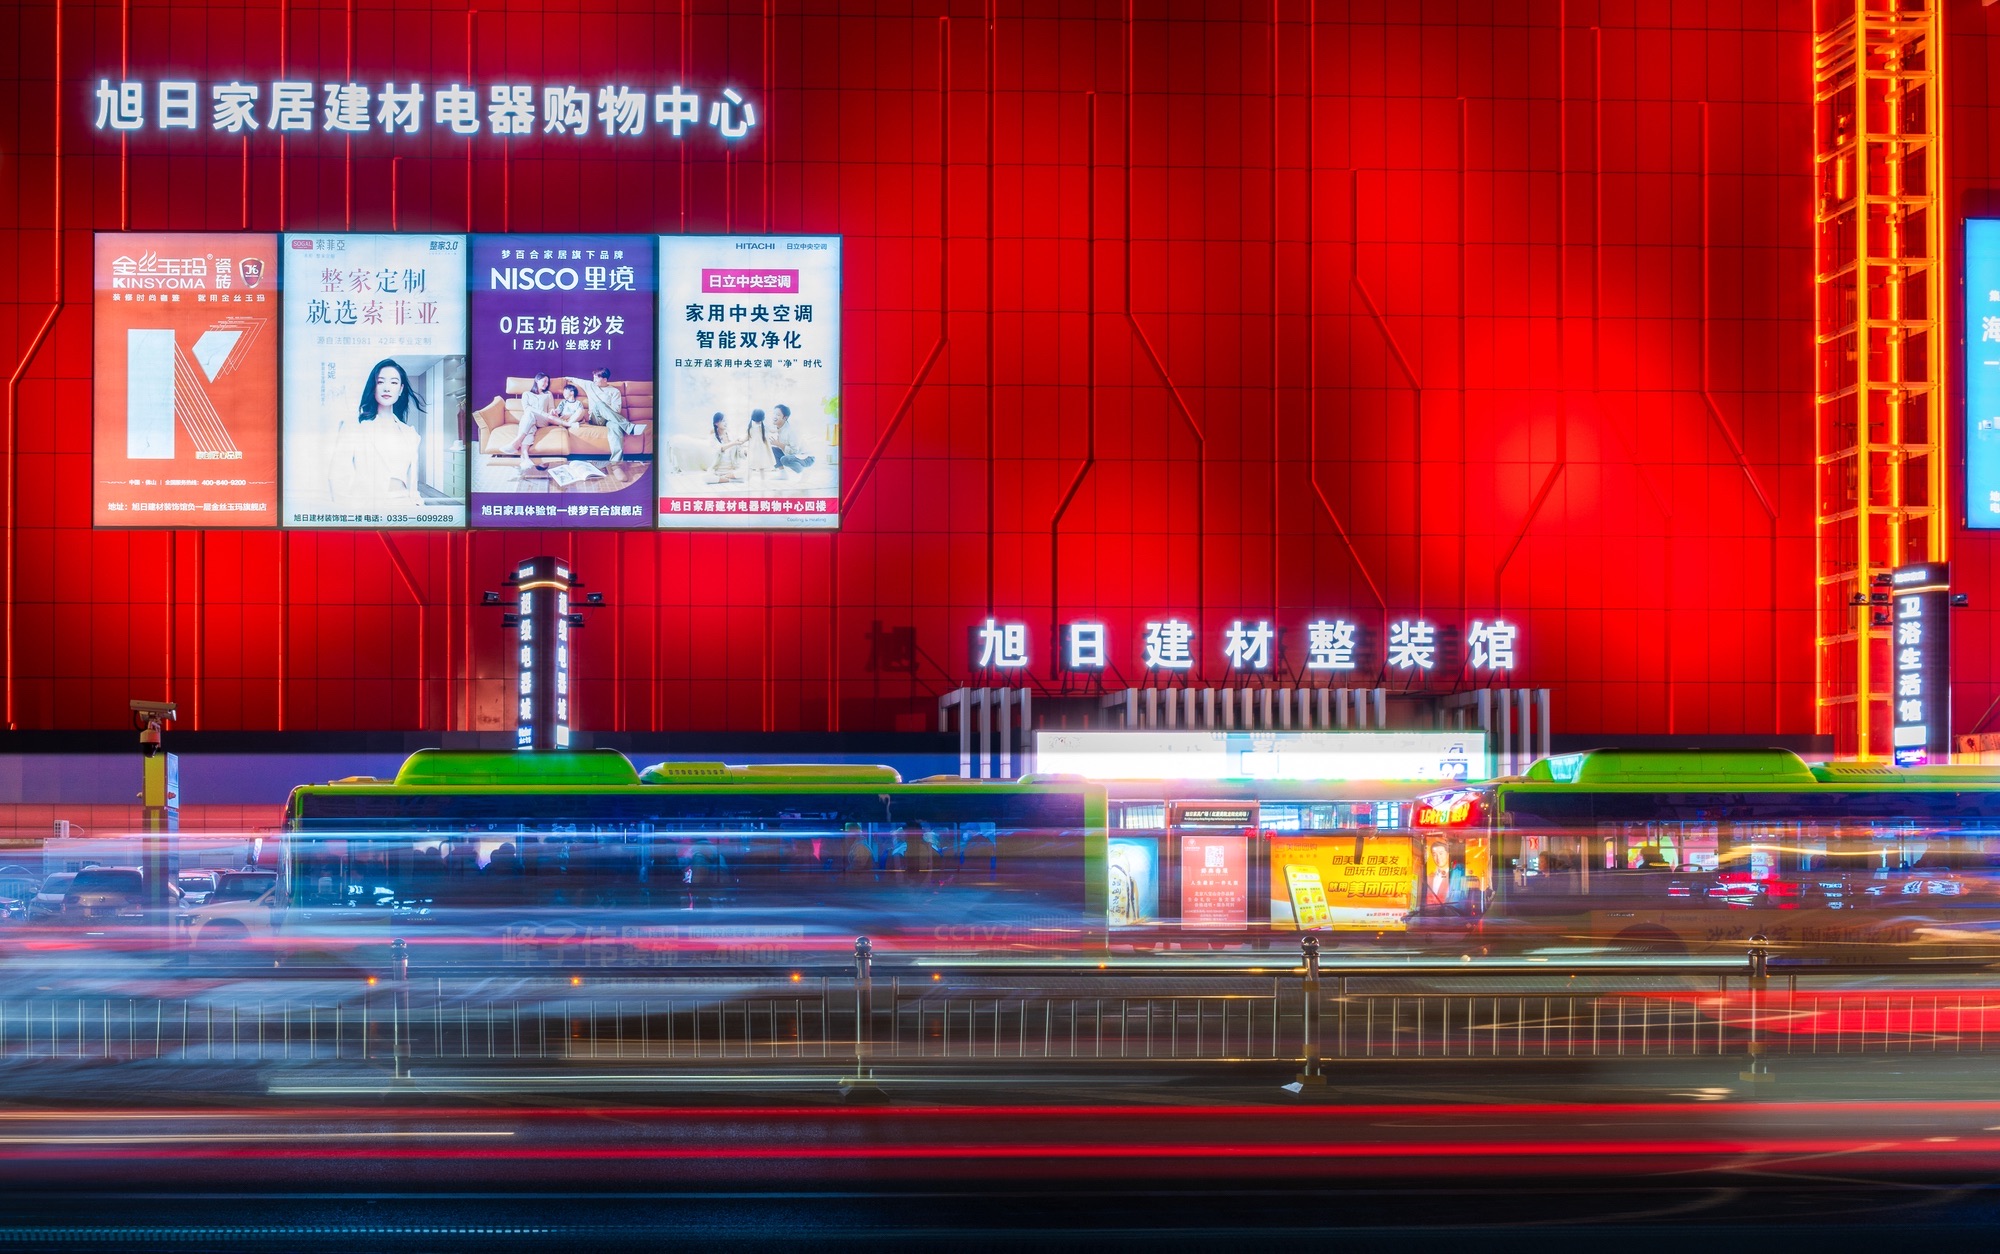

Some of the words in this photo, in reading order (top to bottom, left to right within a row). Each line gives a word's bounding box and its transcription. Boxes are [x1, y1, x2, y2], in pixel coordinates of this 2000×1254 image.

[96, 80, 757, 138] 旭日家居建材电器购物中心
[501, 249, 624, 260] 梦百合家居旗下品牌
[112, 277, 206, 289] KINSYOMA
[215, 257, 232, 290] 瓷砖
[320, 268, 426, 293] 整家定制
[490, 267, 579, 291] NISCO
[709, 275, 791, 288] 日立中央空调
[305, 299, 440, 326] 就选索菲亚
[685, 304, 813, 323] 家用中央空调
[499, 315, 626, 335] 0压功能沙发
[522, 339, 559, 350] 压力小
[565, 339, 602, 350] 坐感好
[696, 330, 803, 350] 智能双净化
[481, 504, 643, 516] 旭日家具体验馆一楼梦百合旗舰店
[670, 500, 827, 512] 旭日家居建材电器购物中心四楼
[979, 620, 1516, 670] 旭日建材整装馆
[1900, 596, 1922, 722] 卫浴生活馆
[1367, 855, 1400, 865] 团美发
[1344, 866, 1376, 876] 团玩乐
